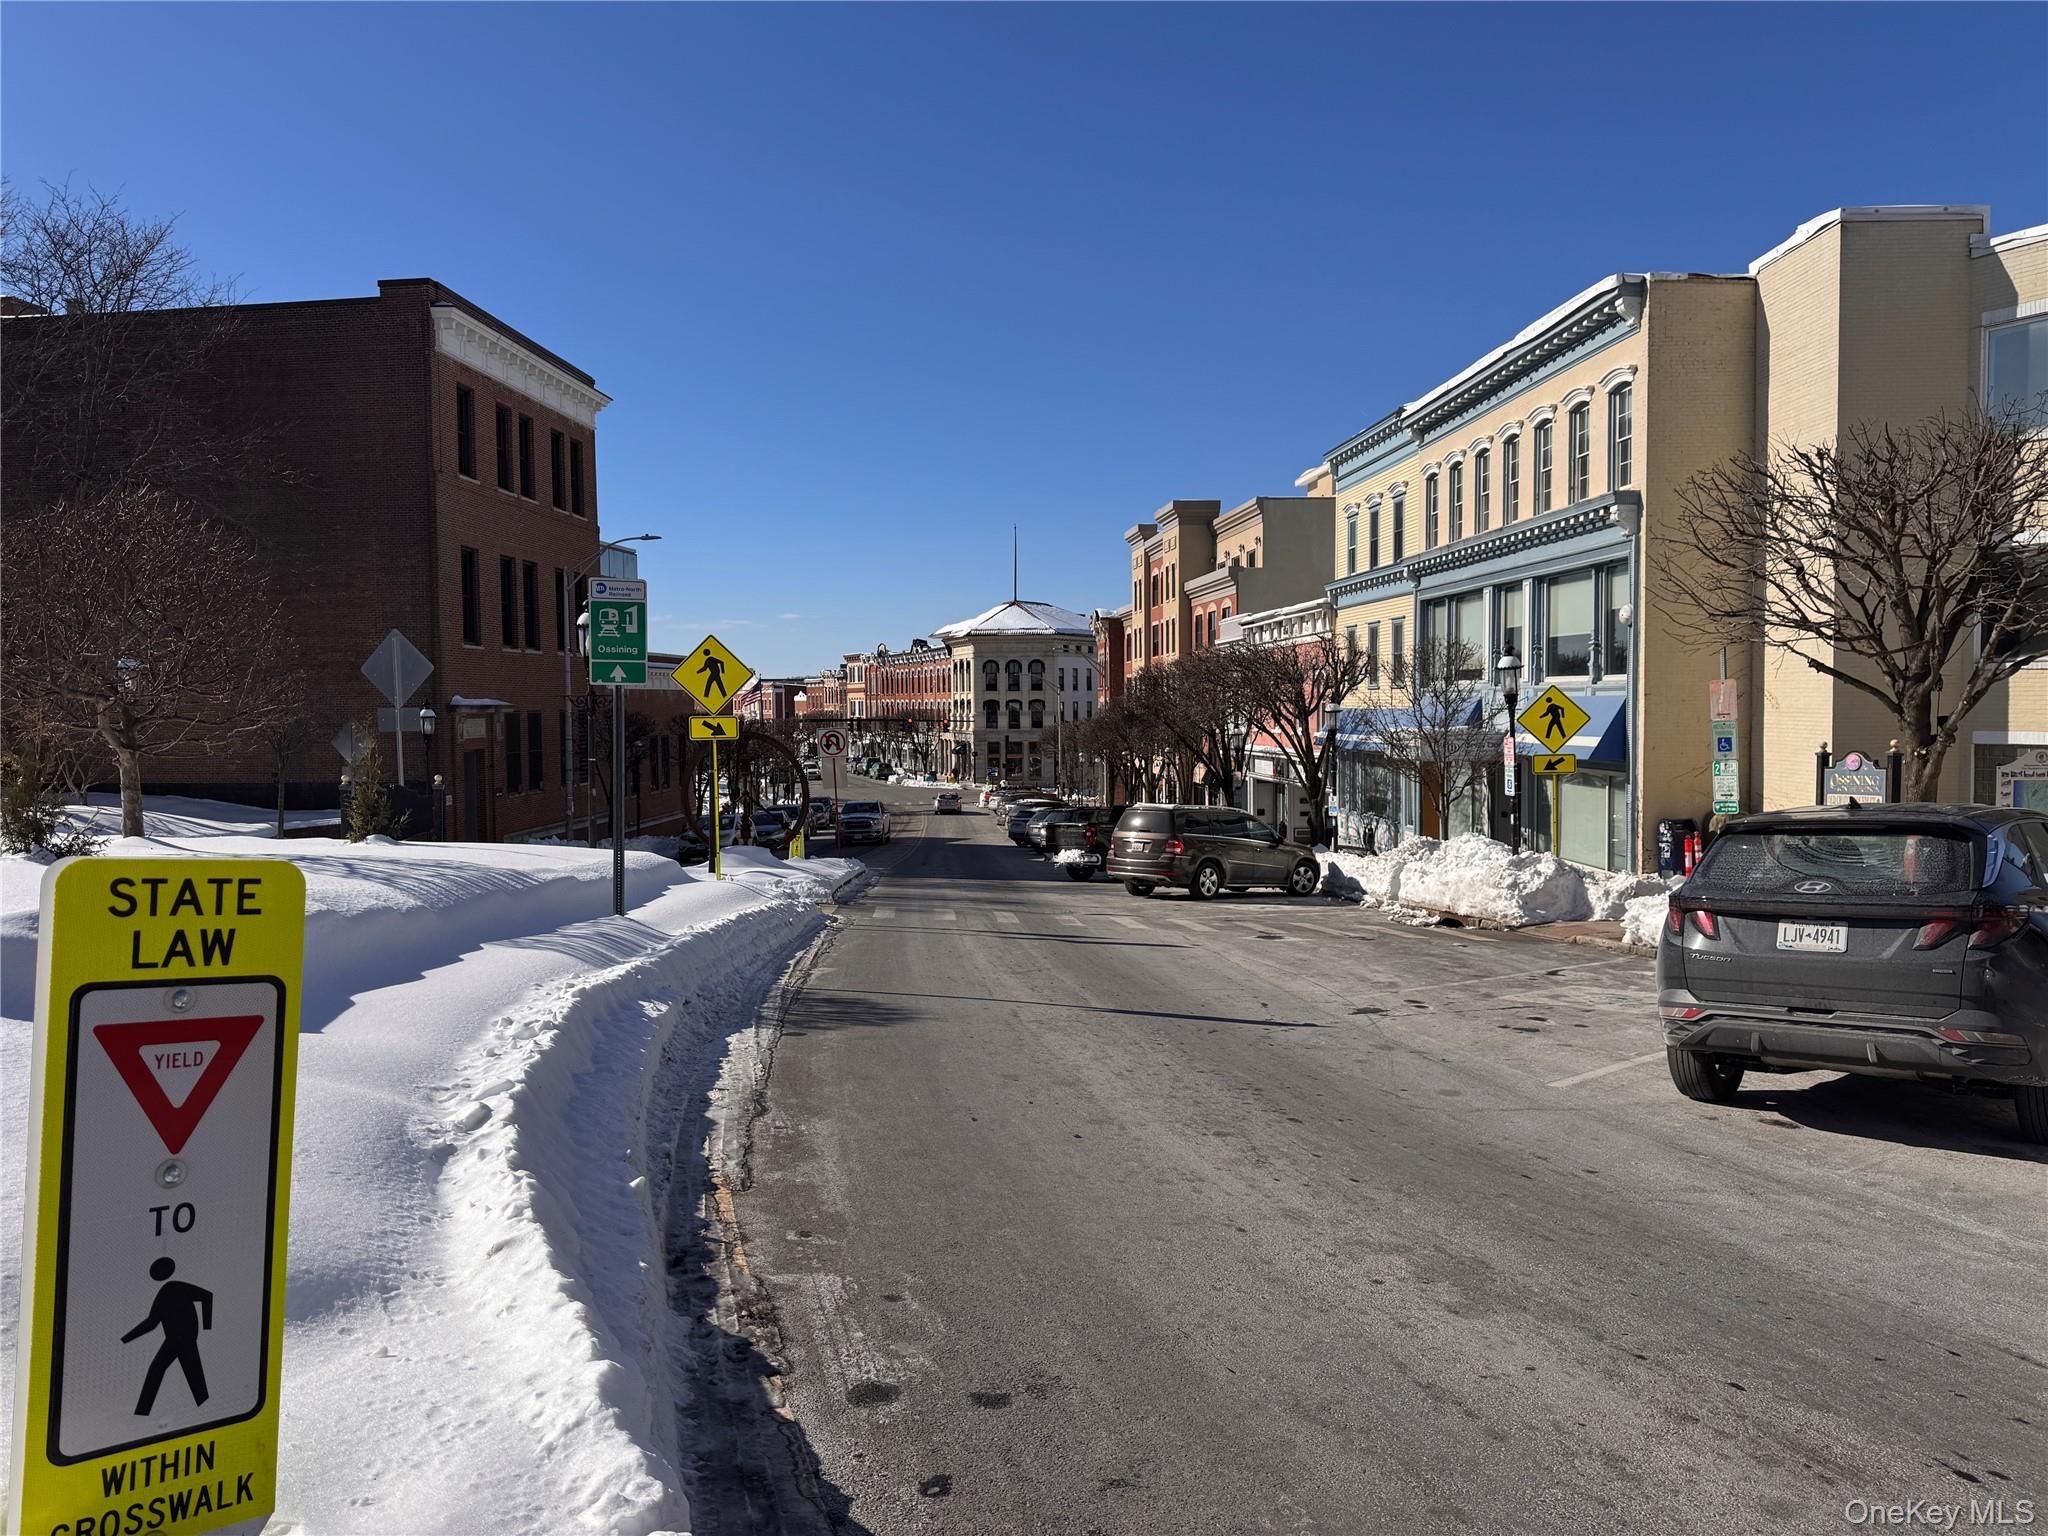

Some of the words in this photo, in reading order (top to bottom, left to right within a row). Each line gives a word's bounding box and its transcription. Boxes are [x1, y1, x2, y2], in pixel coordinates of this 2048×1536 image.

[598, 644, 638, 655] Ossining
[1714, 763, 1720, 775] 2
[108, 877, 262, 918] STATE
[131, 928, 236, 969] LAW
[1783, 926, 1805, 943] LJV
[1812, 928, 1841, 945] 4941
[154, 1051, 204, 1070] YIELD
[149, 1202, 196, 1237] TO
[101, 1440, 216, 1499] WITHIN
